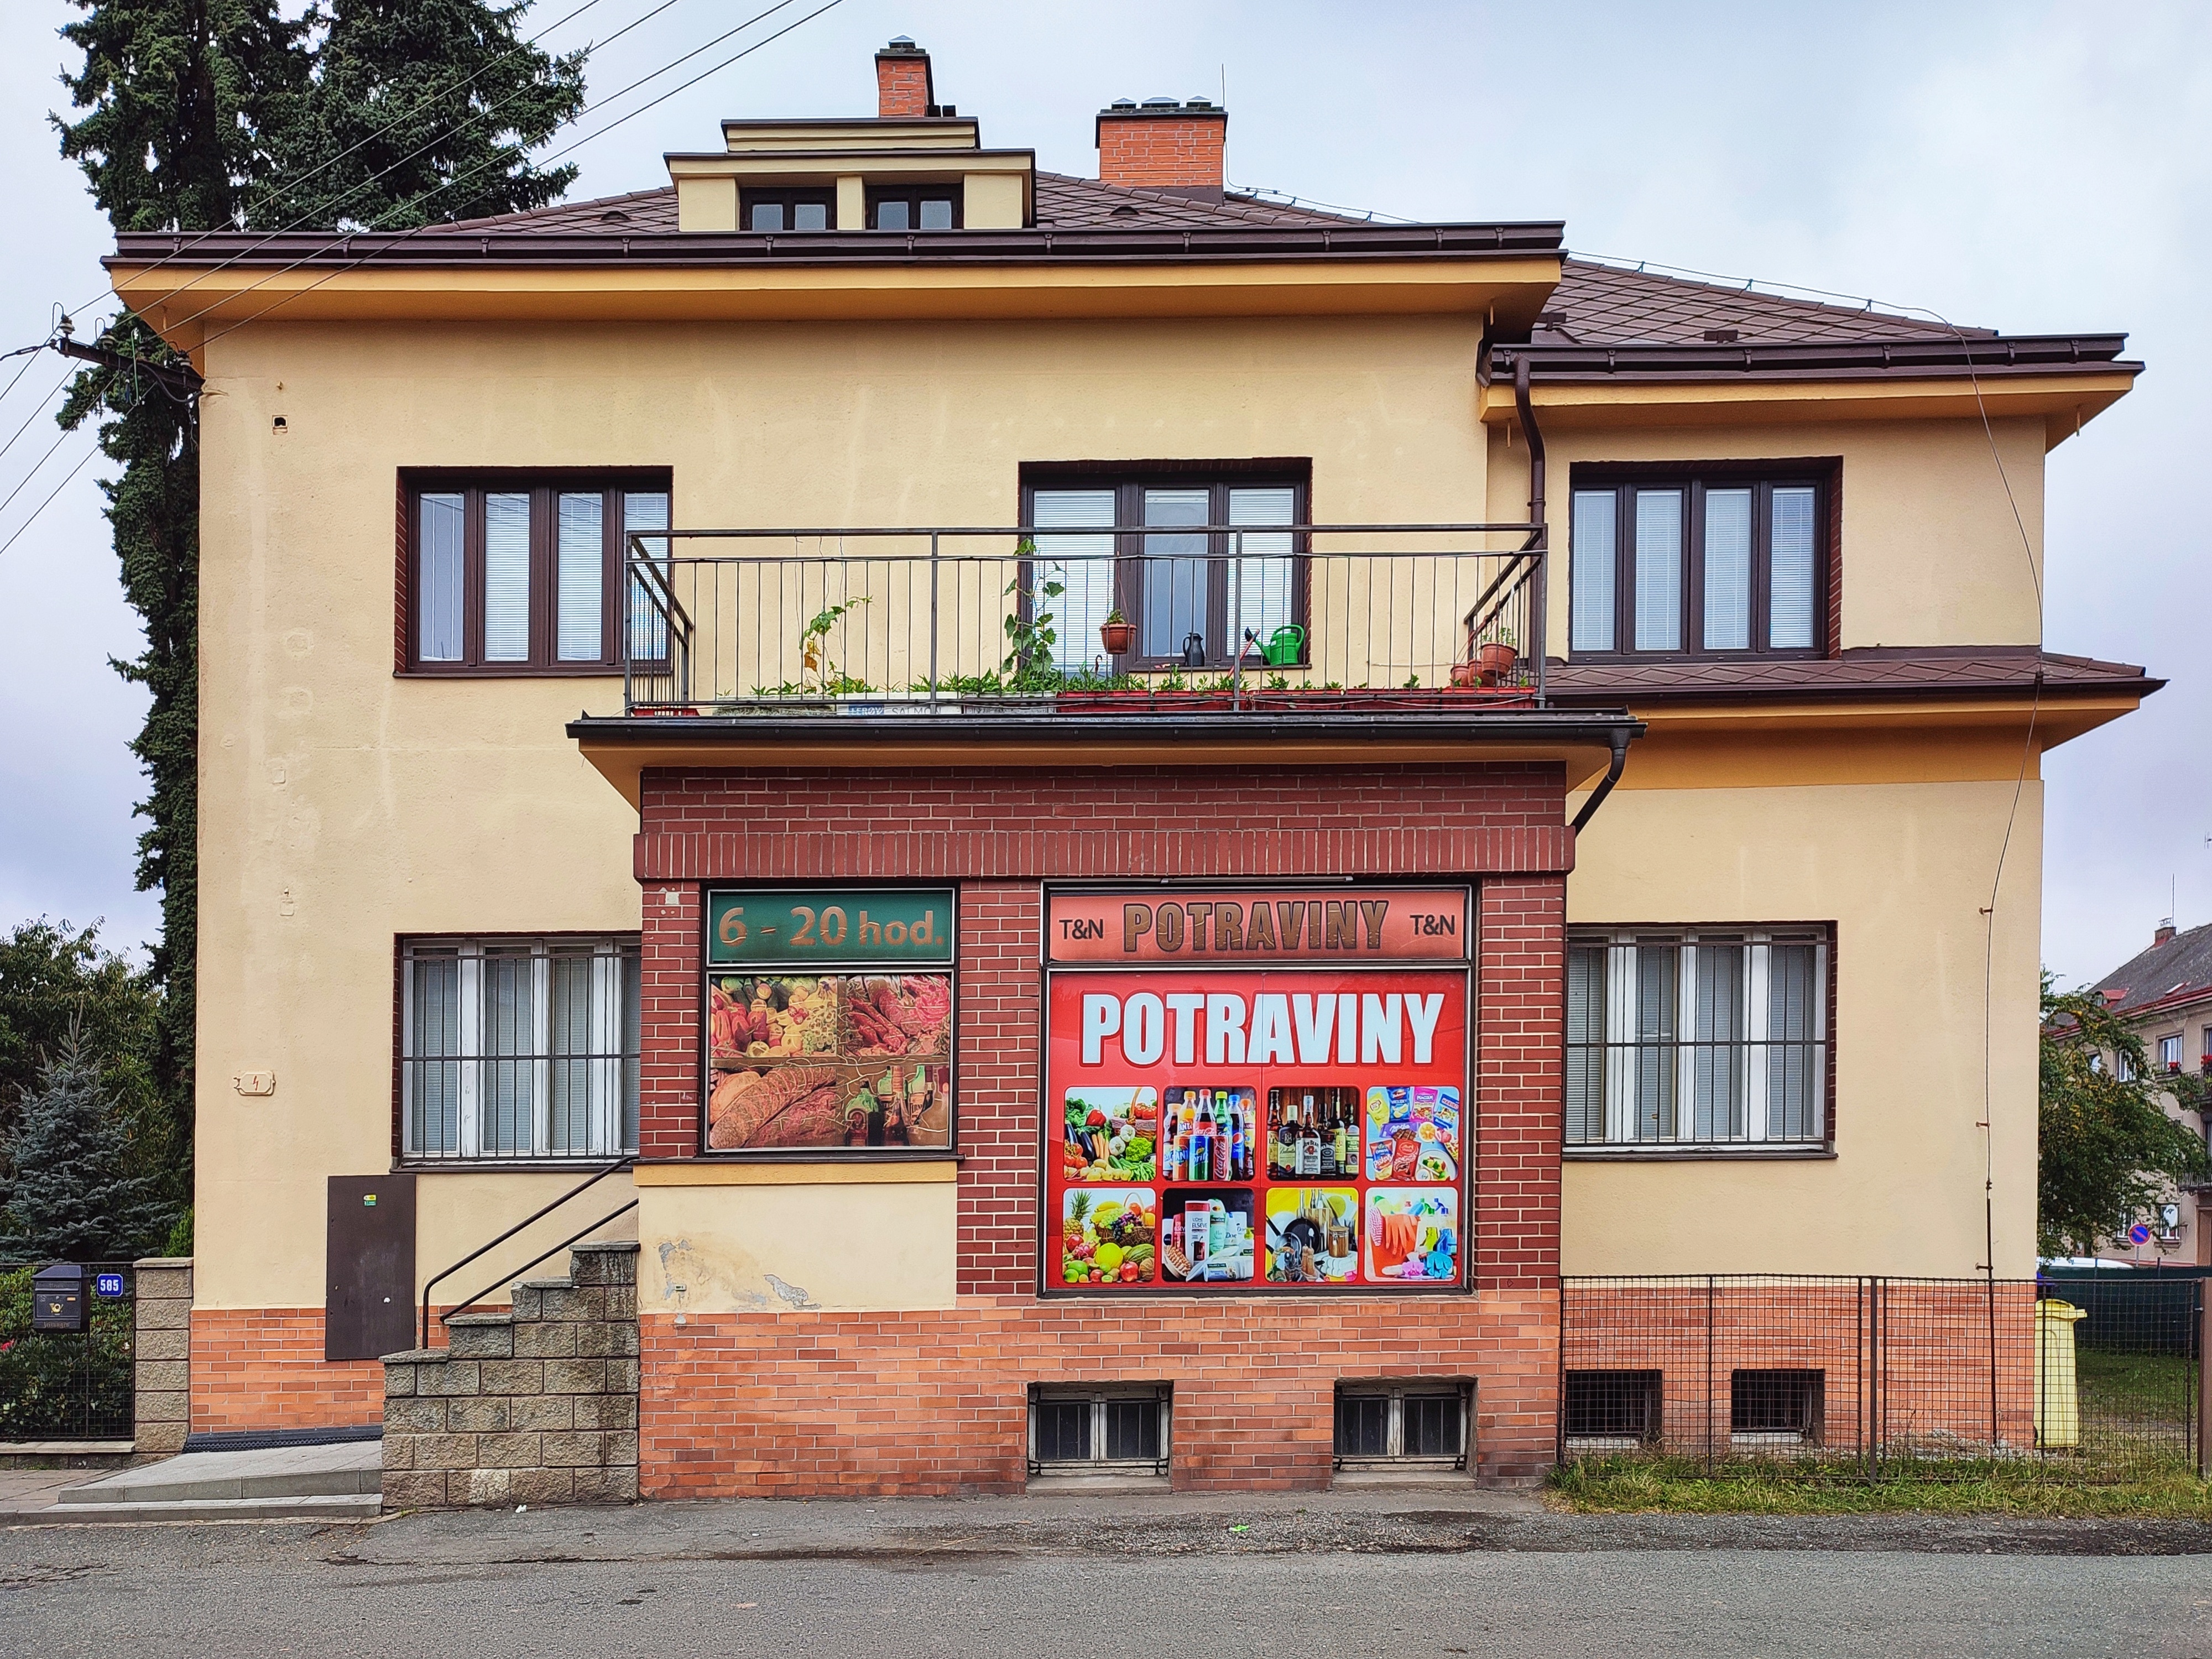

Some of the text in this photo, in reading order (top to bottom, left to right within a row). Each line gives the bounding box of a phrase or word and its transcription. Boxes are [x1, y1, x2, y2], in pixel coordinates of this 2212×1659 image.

[719, 906, 747, 947] 6
[790, 906, 848, 946] 20
[859, 910, 944, 946] hod.
[1058, 900, 1455, 952] T&N POTRAVINY T&N
[1082, 992, 1446, 1066] POTRAVINY
[100, 1279, 119, 1292] 585
